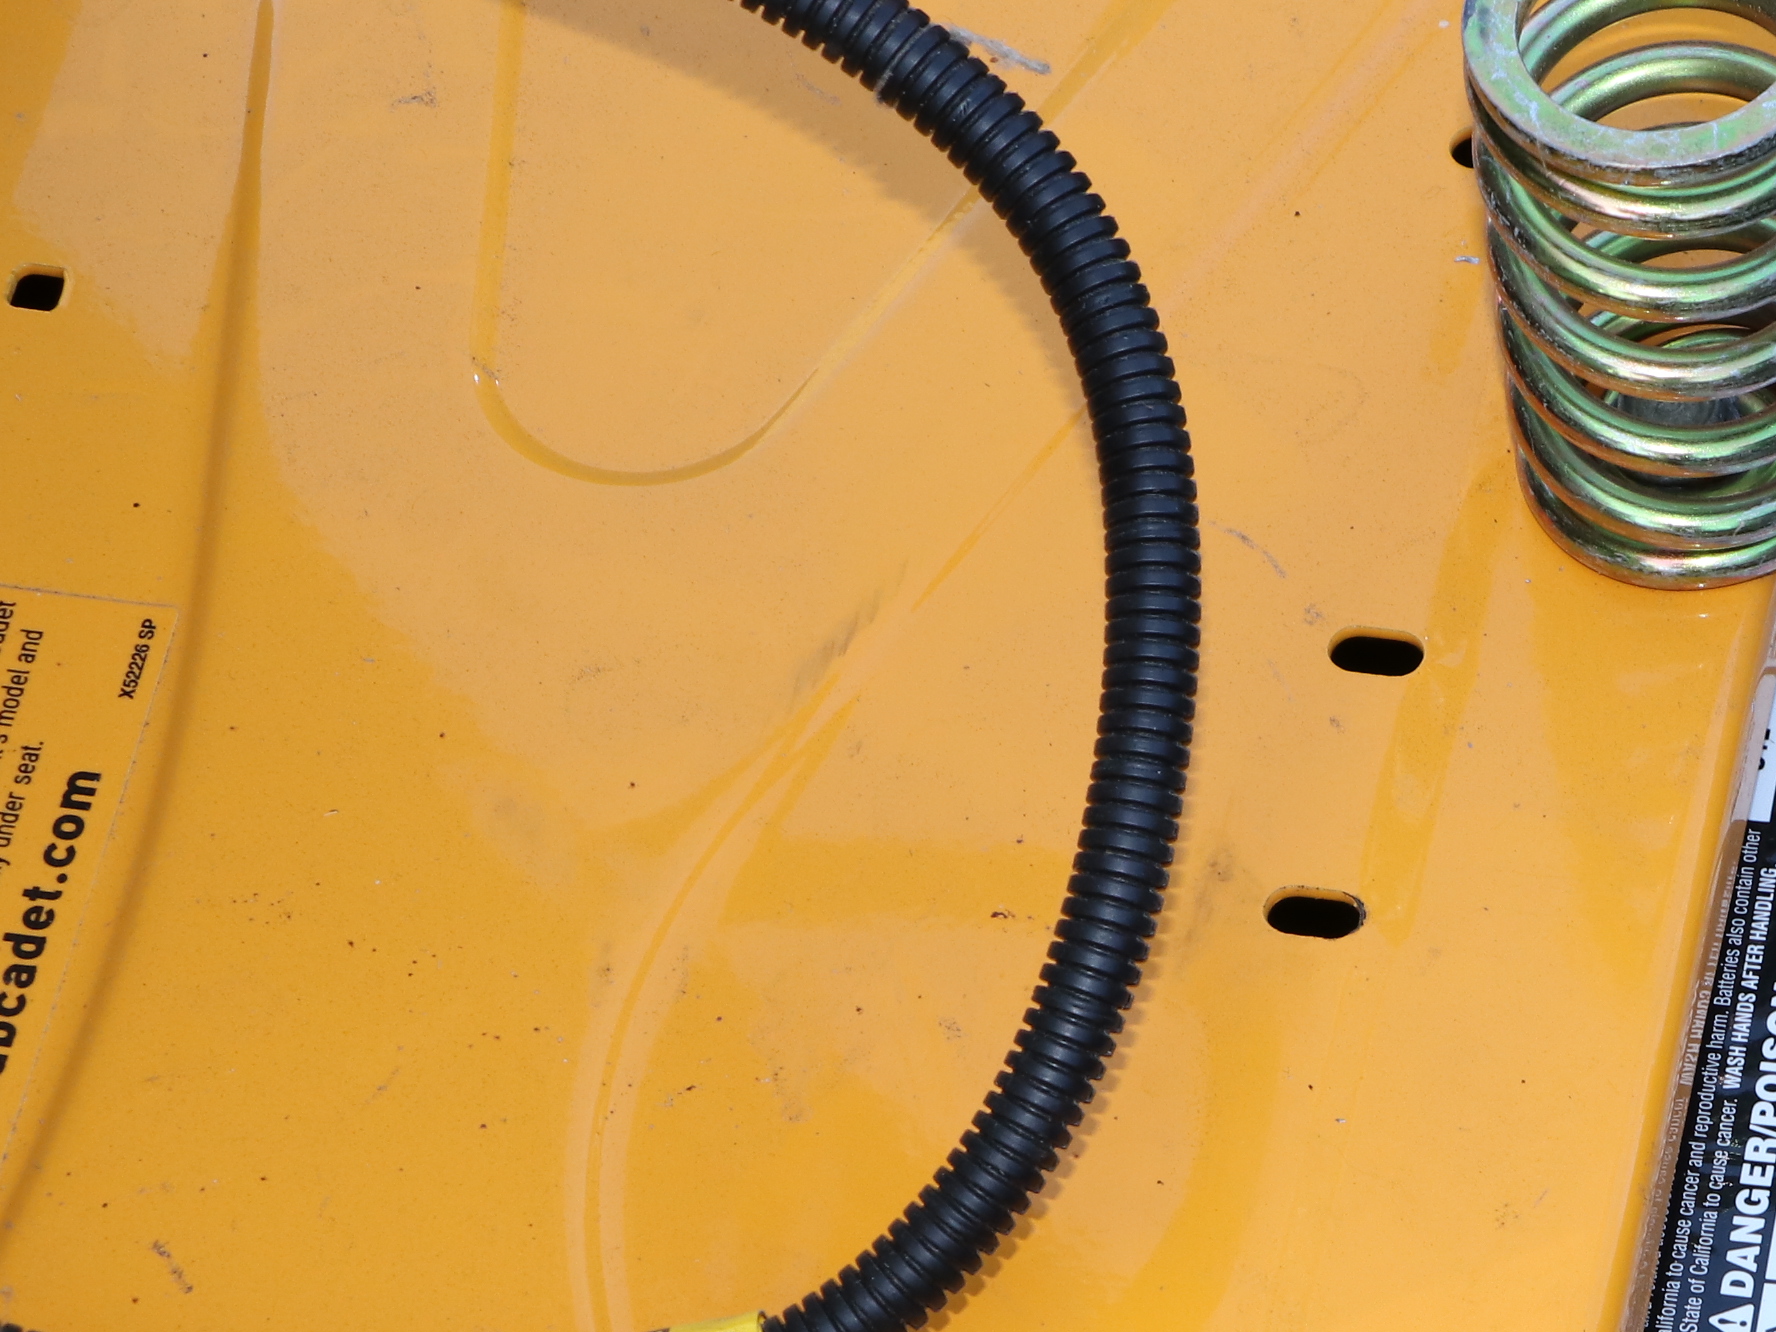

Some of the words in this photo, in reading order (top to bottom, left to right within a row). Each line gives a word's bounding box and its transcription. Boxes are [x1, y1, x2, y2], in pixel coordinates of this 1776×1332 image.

[20, 628, 44, 662] and
[118, 643, 152, 700] X52226
[138, 617, 157, 640] SP
[13, 741, 44, 785] seat.
[1740, 944, 1765, 990] AFTER
[1730, 992, 1756, 1043] HANDS
[1722, 1045, 1747, 1090] WASH
[1716, 1098, 1738, 1147] cancer.
[1708, 1150, 1729, 1190] cause
[1702, 1193, 1721, 1207] to
[1689, 1211, 1718, 1276] California
[1687, 1278, 1706, 1294] of
